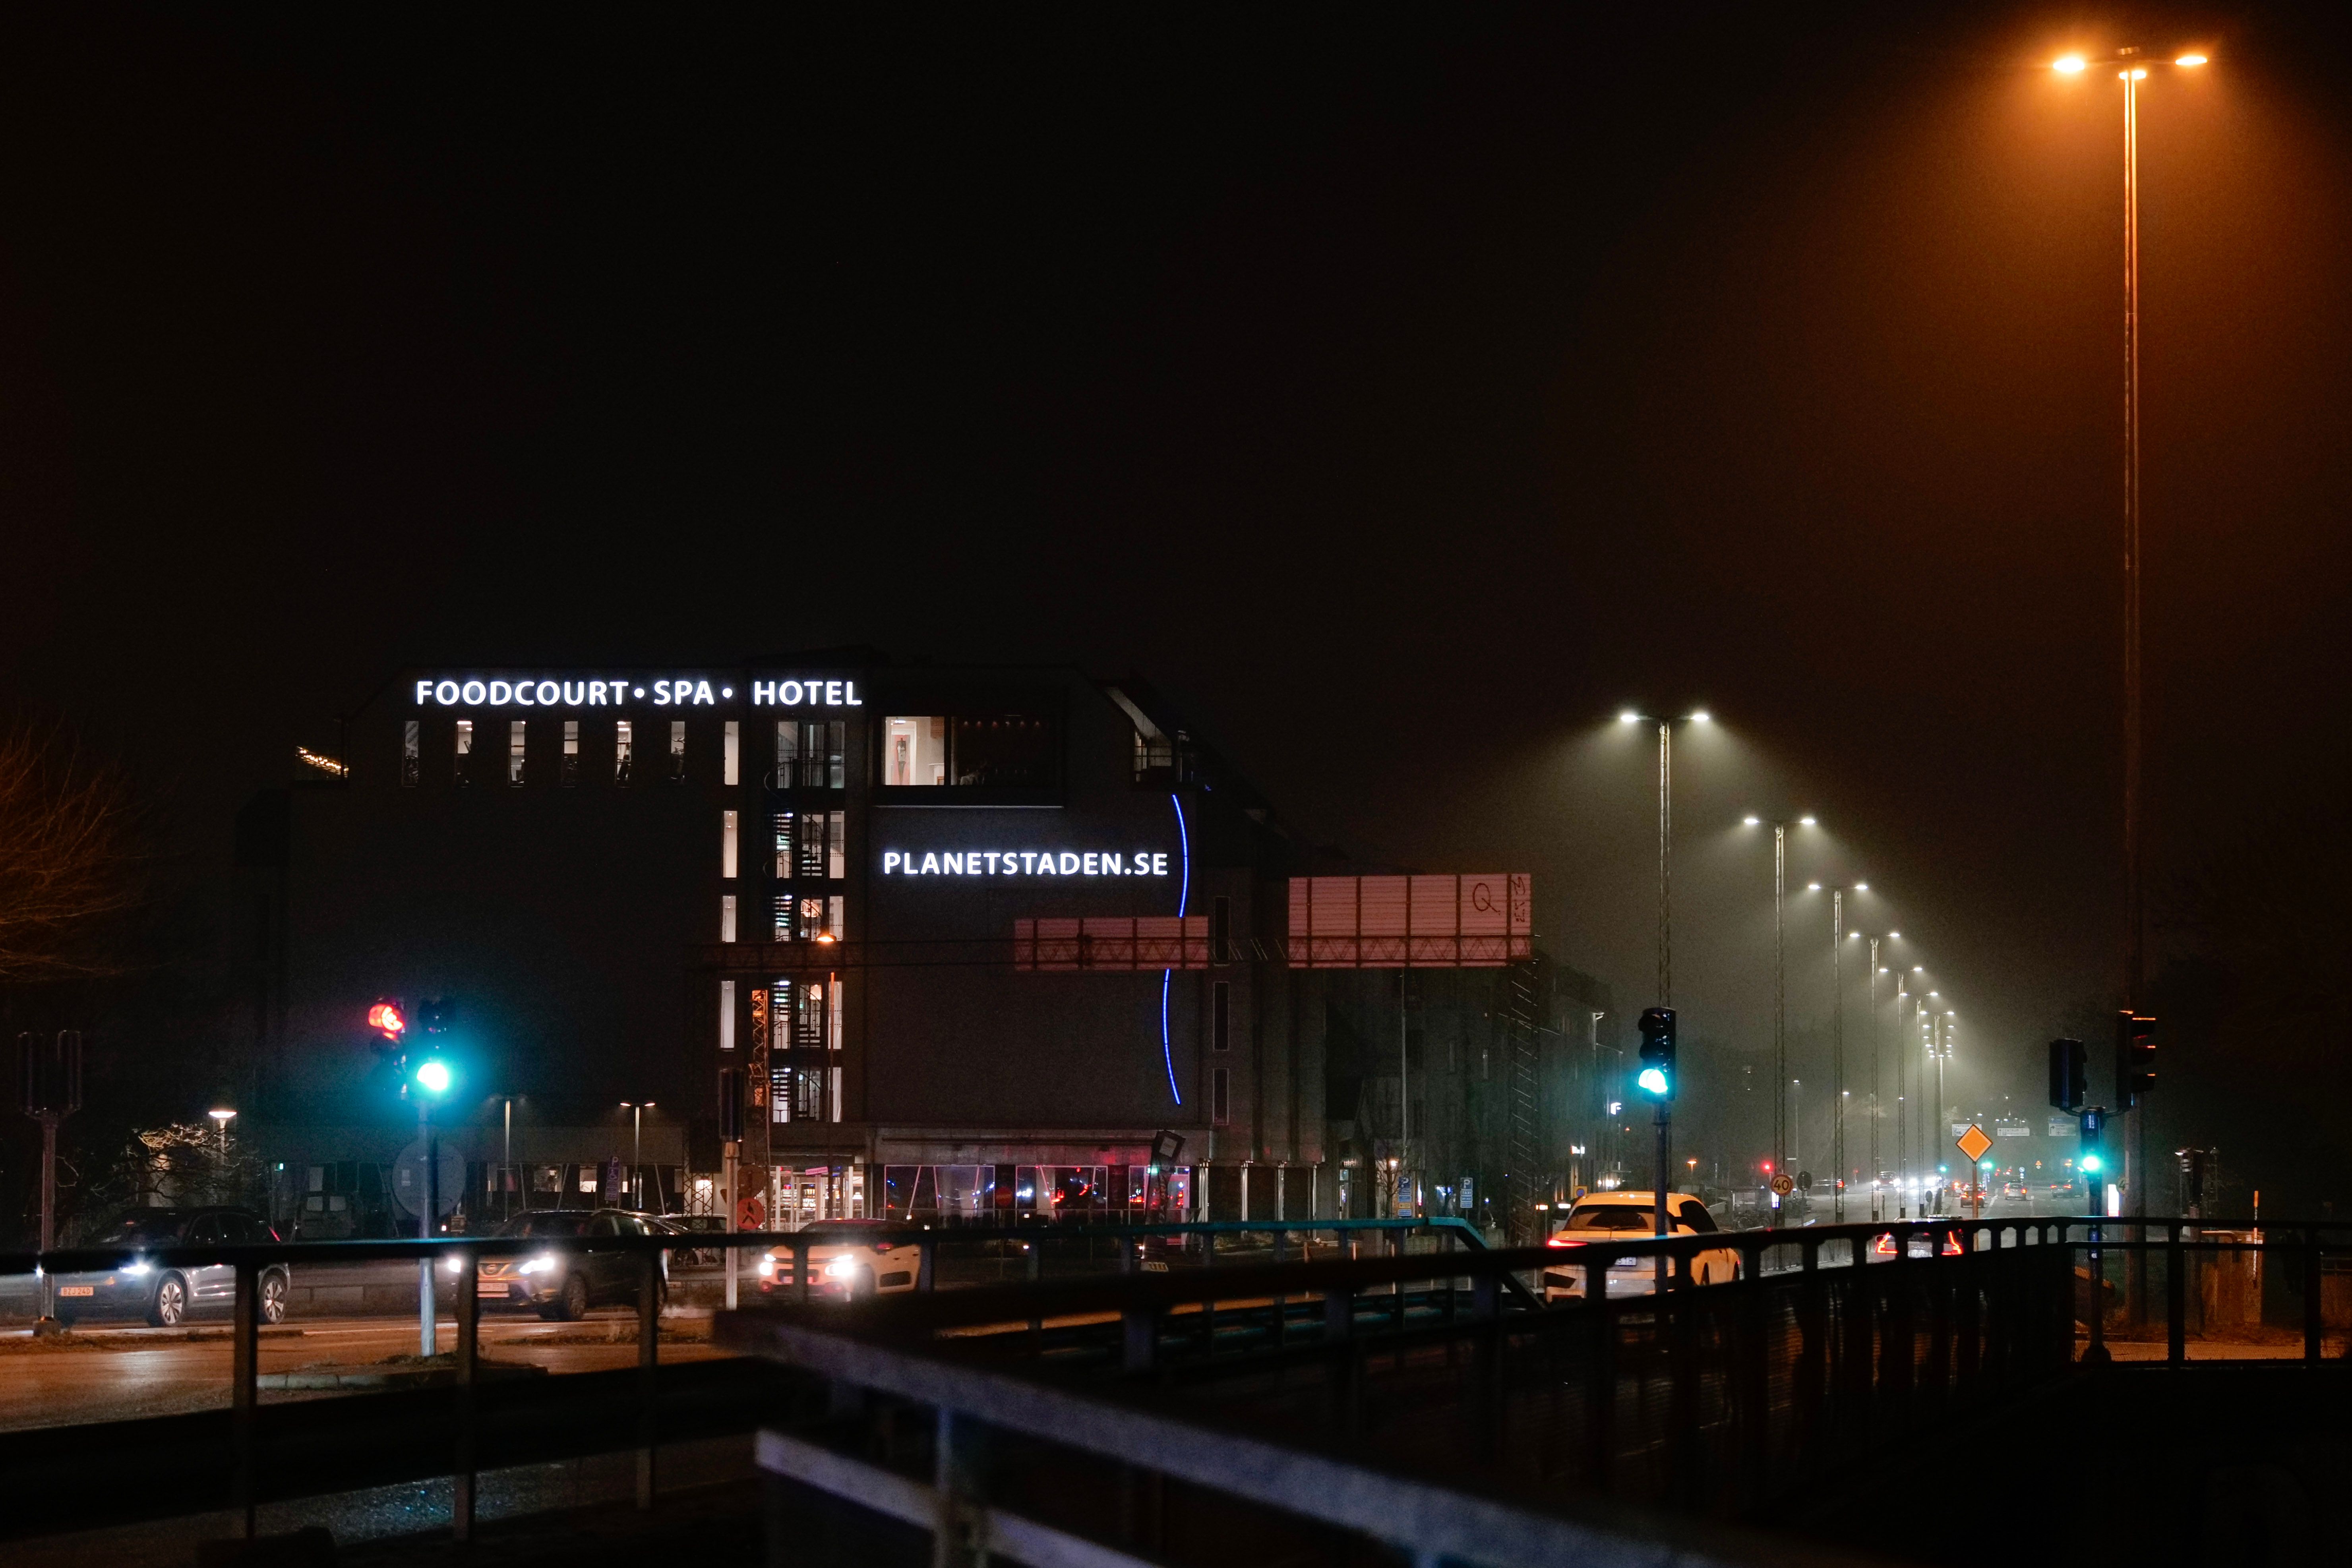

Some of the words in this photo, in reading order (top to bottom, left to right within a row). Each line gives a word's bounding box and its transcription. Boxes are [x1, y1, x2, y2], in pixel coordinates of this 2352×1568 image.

[417, 681, 629, 706] FOODCOURT
[654, 681, 714, 705] SPA
[754, 681, 862, 706] HOTEL
[884, 852, 1168, 875] PLANETSTADEN.SE
[1463, 1179, 1470, 1189] P
[1774, 1180, 1789, 1191] 40
